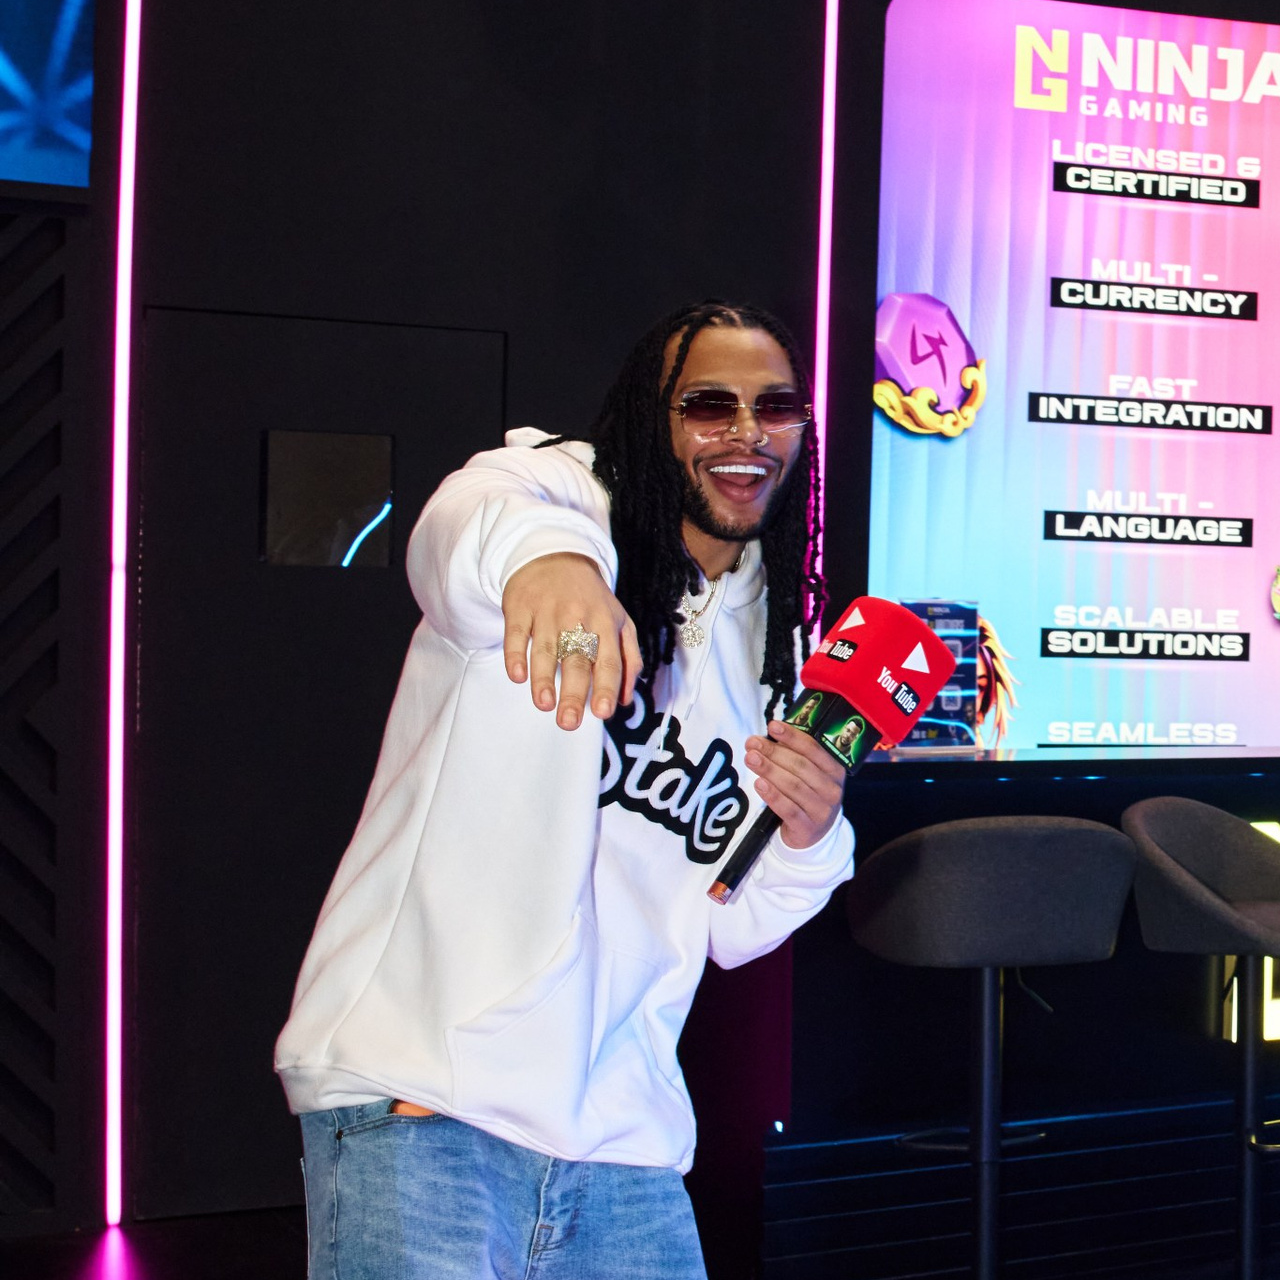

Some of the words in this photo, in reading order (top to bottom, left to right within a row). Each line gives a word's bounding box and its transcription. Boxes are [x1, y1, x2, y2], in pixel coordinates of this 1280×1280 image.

[1079, 94, 1209, 127] GAMING
[1051, 138, 1226, 176] LICENSED
[1236, 155, 1262, 179] &
[1065, 166, 1247, 204] CERTIFIED
[1090, 257, 1192, 286] MULTI
[1059, 281, 1248, 316] CURRENCY
[1108, 374, 1198, 401] FAST
[1038, 396, 1263, 431] INTEGRATION
[1086, 489, 1188, 514] MULTI
[1054, 513, 1243, 543] LANGUAGE
[1053, 604, 1240, 631] SCALABLE
[1047, 630, 1244, 657] SOLUTIONS
[1047, 721, 1239, 745] SEAMLESS
